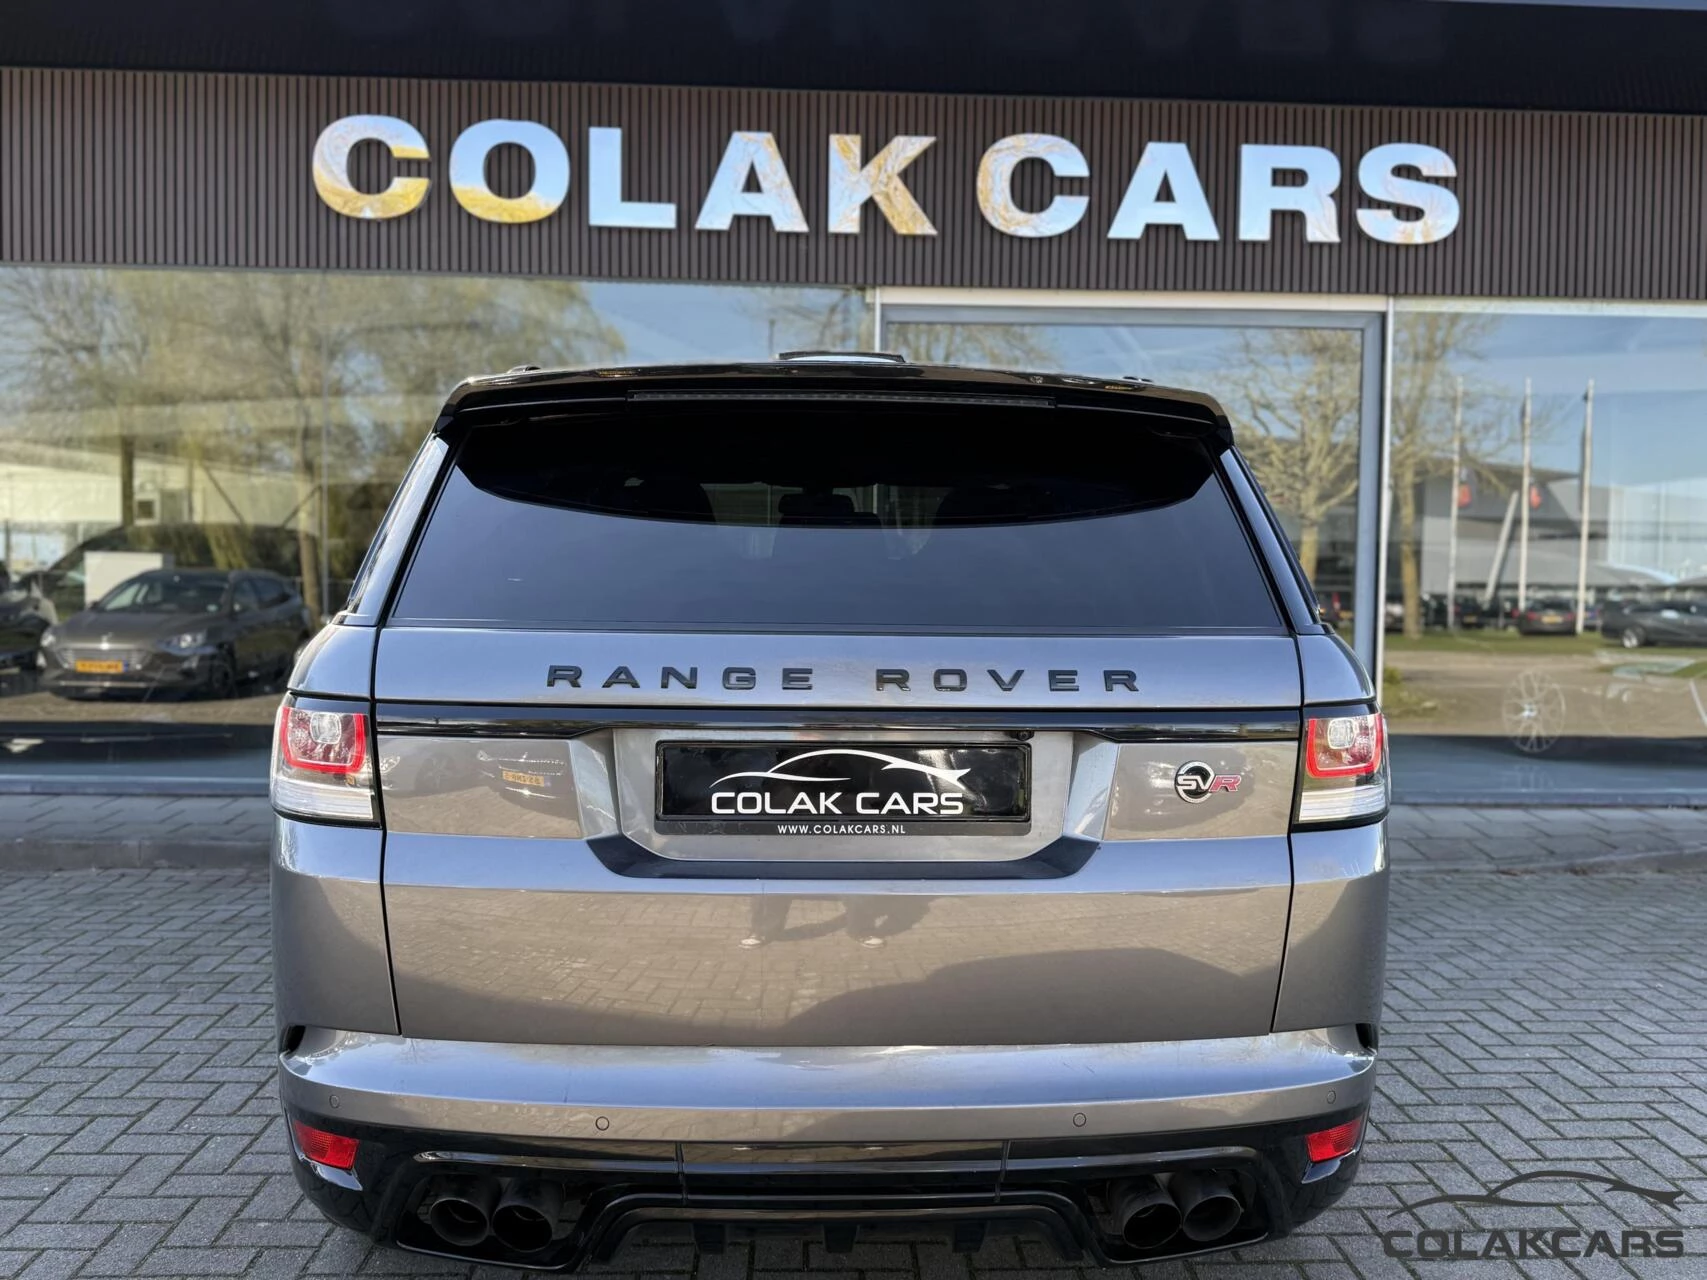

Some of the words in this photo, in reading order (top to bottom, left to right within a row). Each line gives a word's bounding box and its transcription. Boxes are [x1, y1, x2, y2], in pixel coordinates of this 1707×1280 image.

[312, 113, 938, 237] COLAK
[976, 132, 1461, 245] CARS
[547, 664, 813, 690] RANGE
[876, 668, 1139, 692] ROVER
[711, 791, 842, 815] COLAK
[856, 792, 964, 815] CARS
[777, 824, 906, 835] WWW.COLAKCARS.NL
